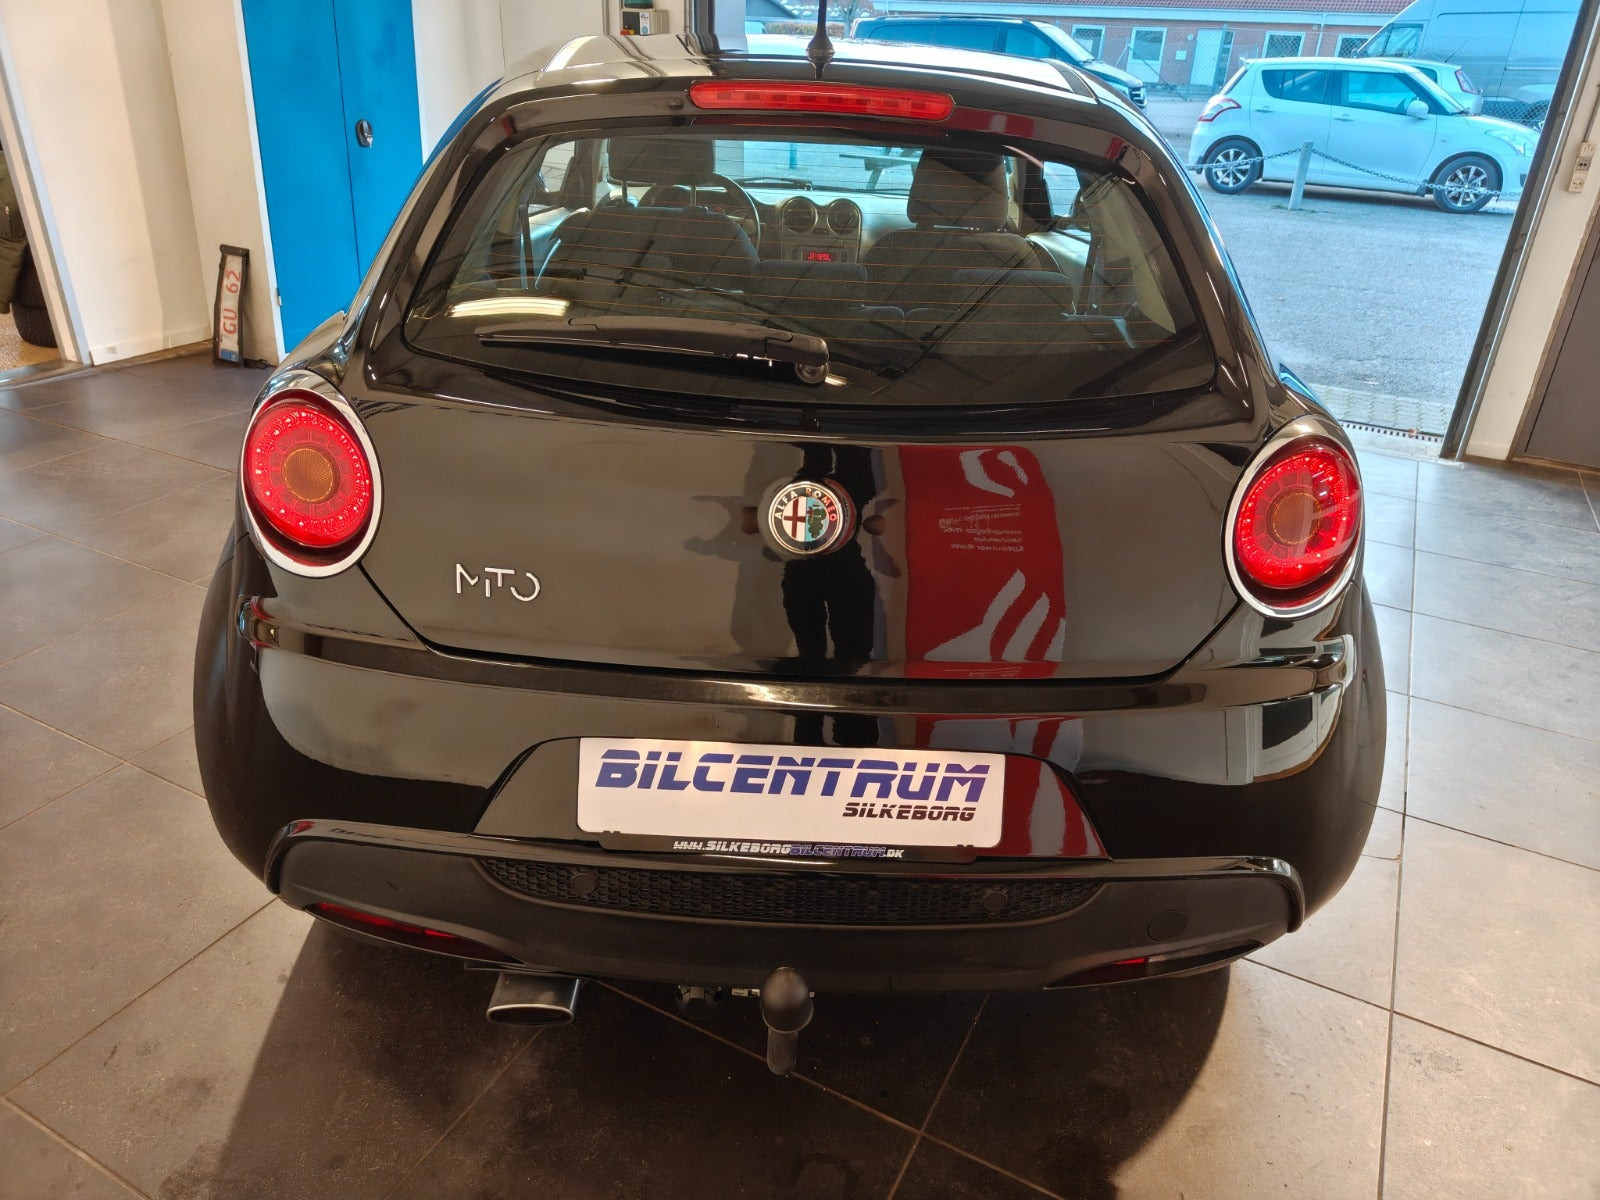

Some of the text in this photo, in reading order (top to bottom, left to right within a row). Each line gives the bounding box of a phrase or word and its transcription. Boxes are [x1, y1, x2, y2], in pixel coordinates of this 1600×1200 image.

[225, 269, 242, 294] 62
[222, 308, 238, 335] GU
[774, 487, 838, 522] ALFA ROMEO
[595, 748, 991, 803] BILCENTRUM
[842, 801, 977, 823] SILKEBORG
